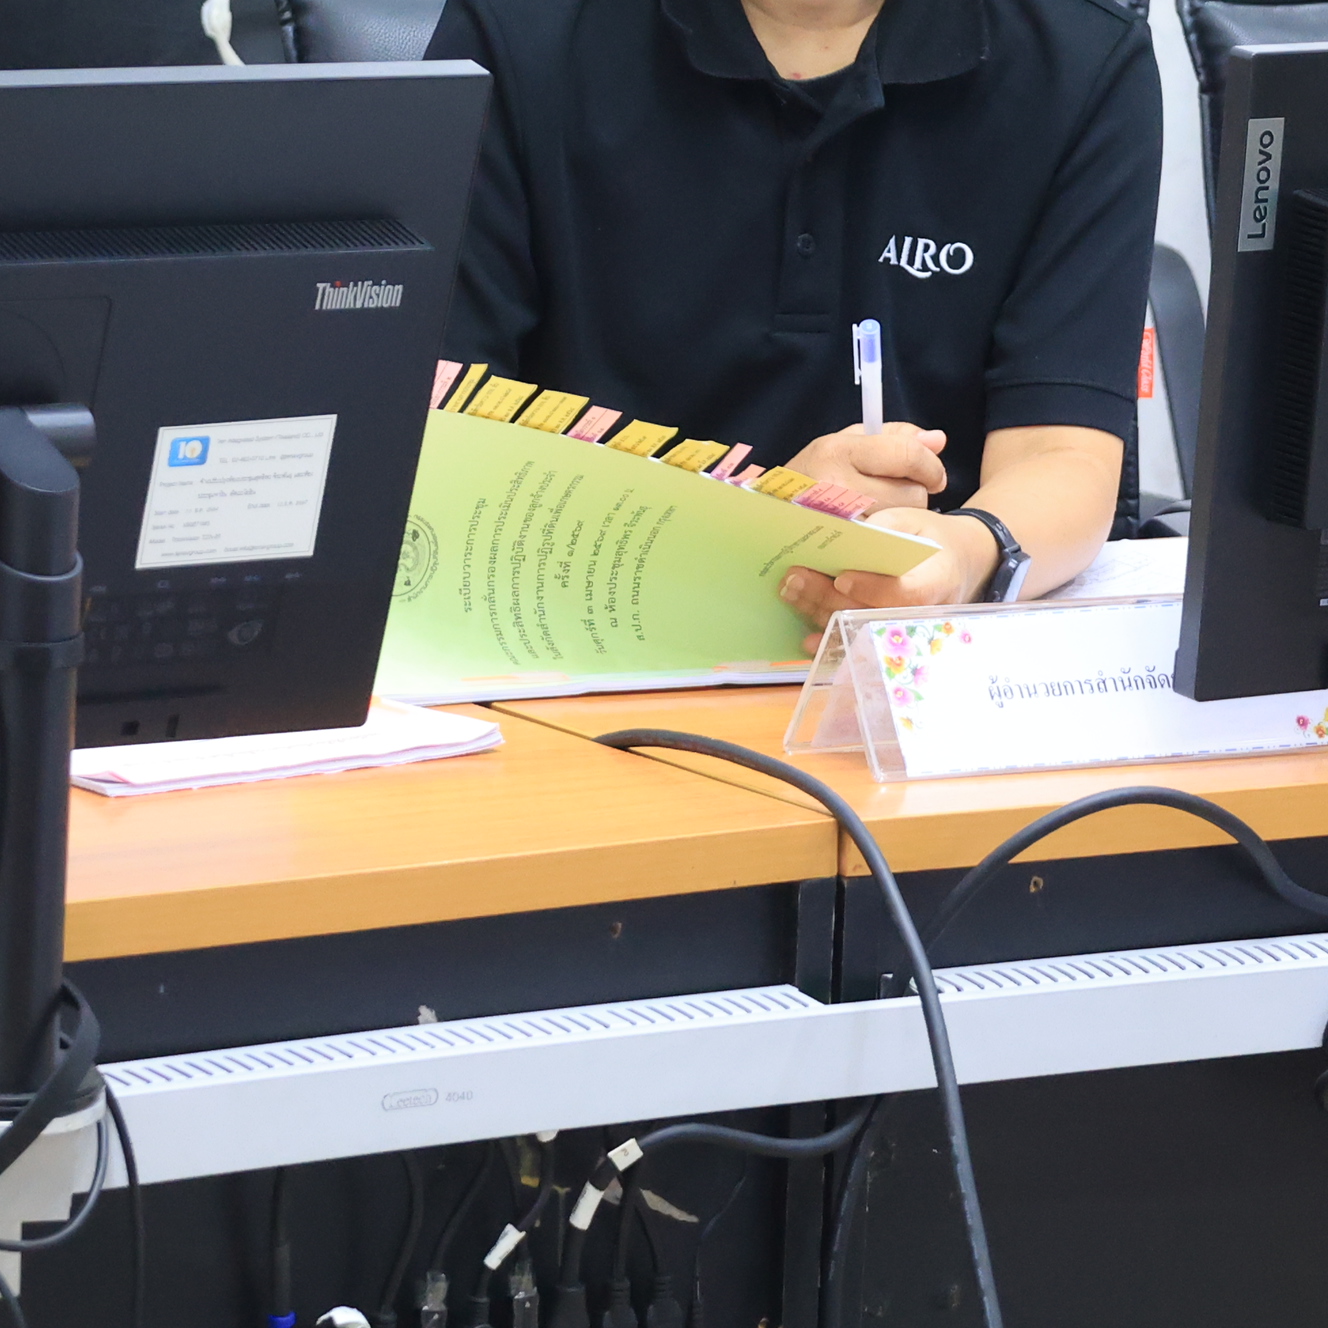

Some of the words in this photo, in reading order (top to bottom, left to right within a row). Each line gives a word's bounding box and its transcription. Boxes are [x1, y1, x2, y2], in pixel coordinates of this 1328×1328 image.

[1247, 130, 1274, 239] Lenovo
[315, 279, 403, 310] ThinkVision
[602, 512, 616, 528] เวลา
[458, 497, 488, 613] ระเบียบวาระการประชุม
[481, 460, 535, 665] คณะกรรมการกลั่นกรองผลการประเมินประสิทธิภาพ
[509, 470, 557, 659] และประสิทธิผลการปฏิบัติงานของลูกจ้างประจำ
[533, 474, 584, 660] ในสังกัดสำนักงานการปฏิรูปที่ดินเพื่อเกษตรกรรม
[554, 560, 572, 589] ครั้งที่
[566, 520, 585, 557] ๑/๒๕๖๙
[584, 559, 598, 601] เมษายน
[603, 529, 633, 615] ห้องประชุมสุทธิพร
[631, 526, 661, 606] ถนนราชดำเนินนอก
[583, 618, 607, 654] วันศุกร์ที่
[587, 606, 594, 615] ๓
[610, 618, 618, 628] ณ
[631, 609, 646, 641] ส.ป.ก.
[988, 665, 1175, 708] ผู้อำนวยการสำนักจัด
